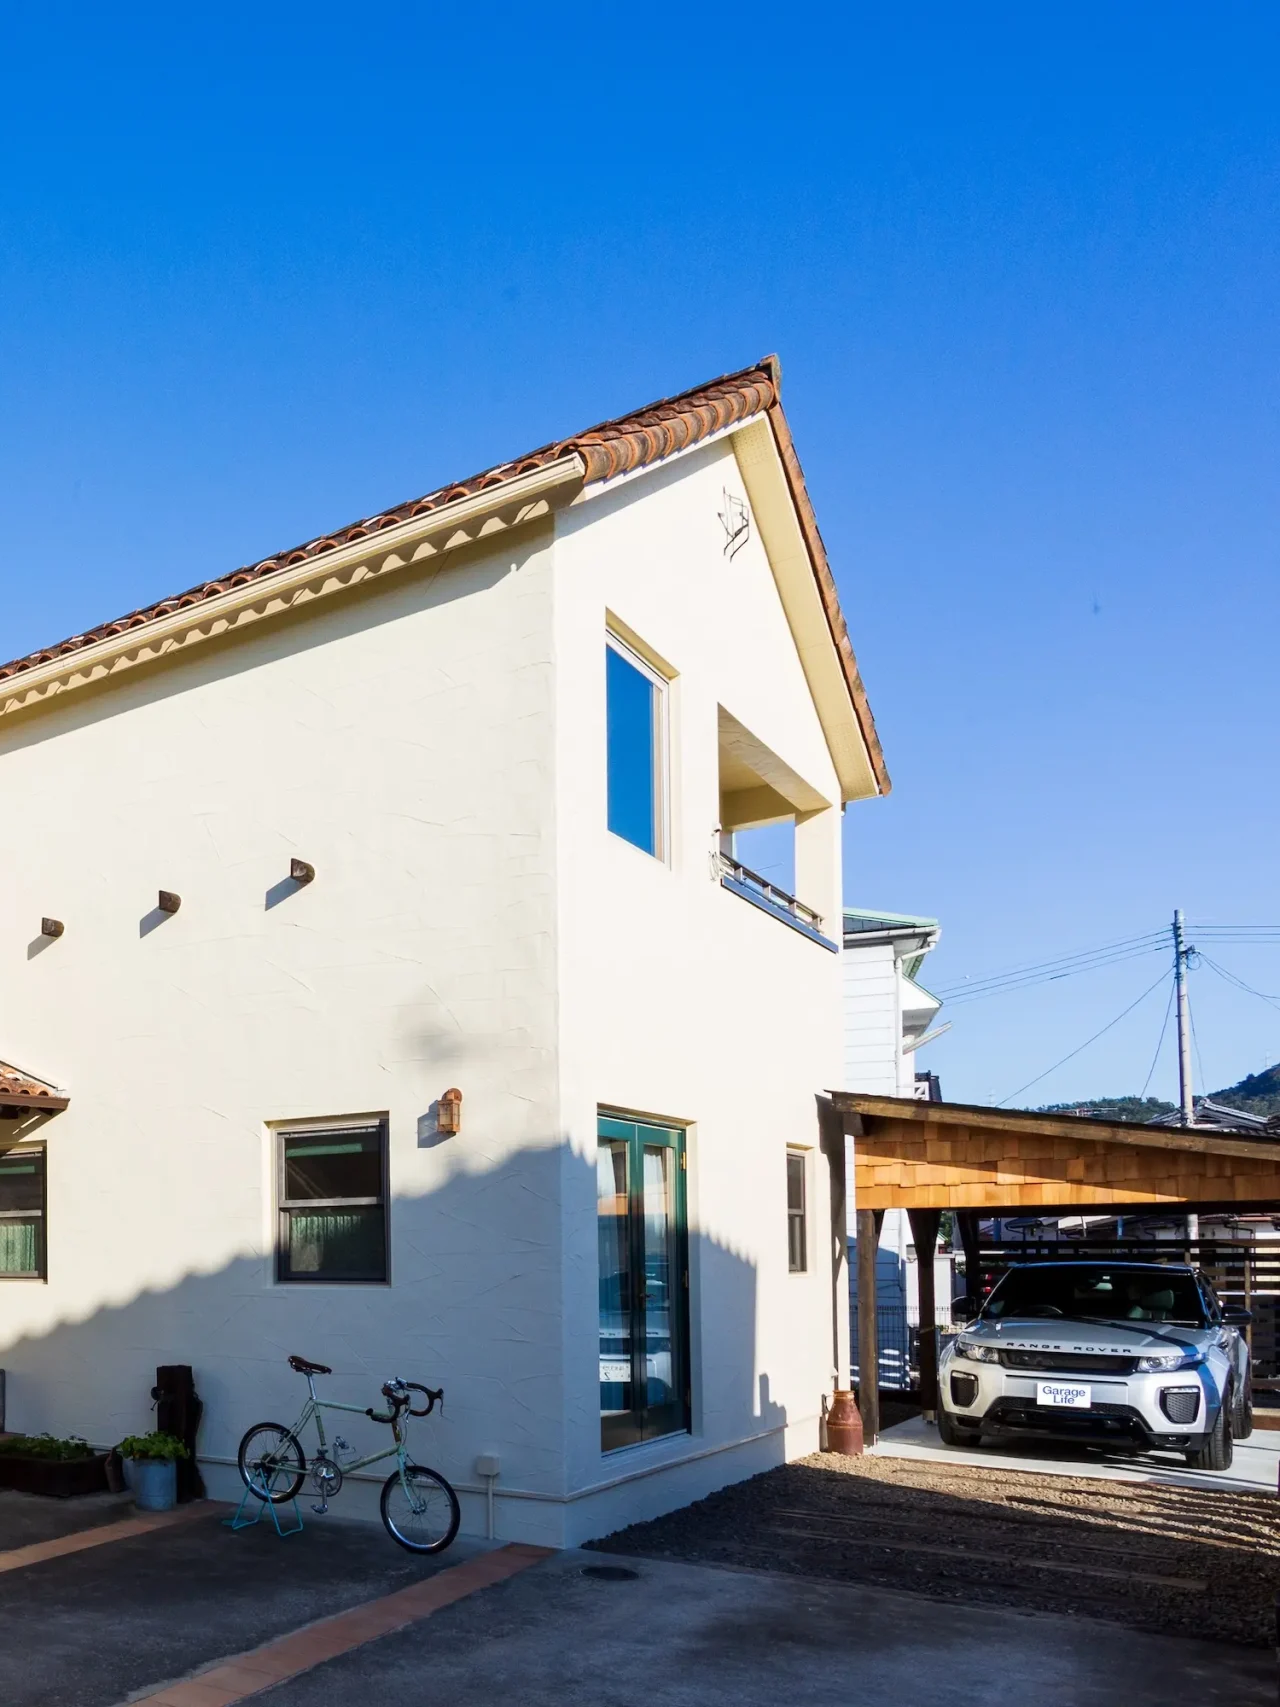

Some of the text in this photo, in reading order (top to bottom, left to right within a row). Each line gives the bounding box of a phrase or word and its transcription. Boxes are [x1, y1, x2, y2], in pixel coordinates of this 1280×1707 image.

[1006, 1342, 1061, 1350] RANGE
[1042, 1386, 1086, 1398] Garage
[1053, 1394, 1075, 1404] Life
